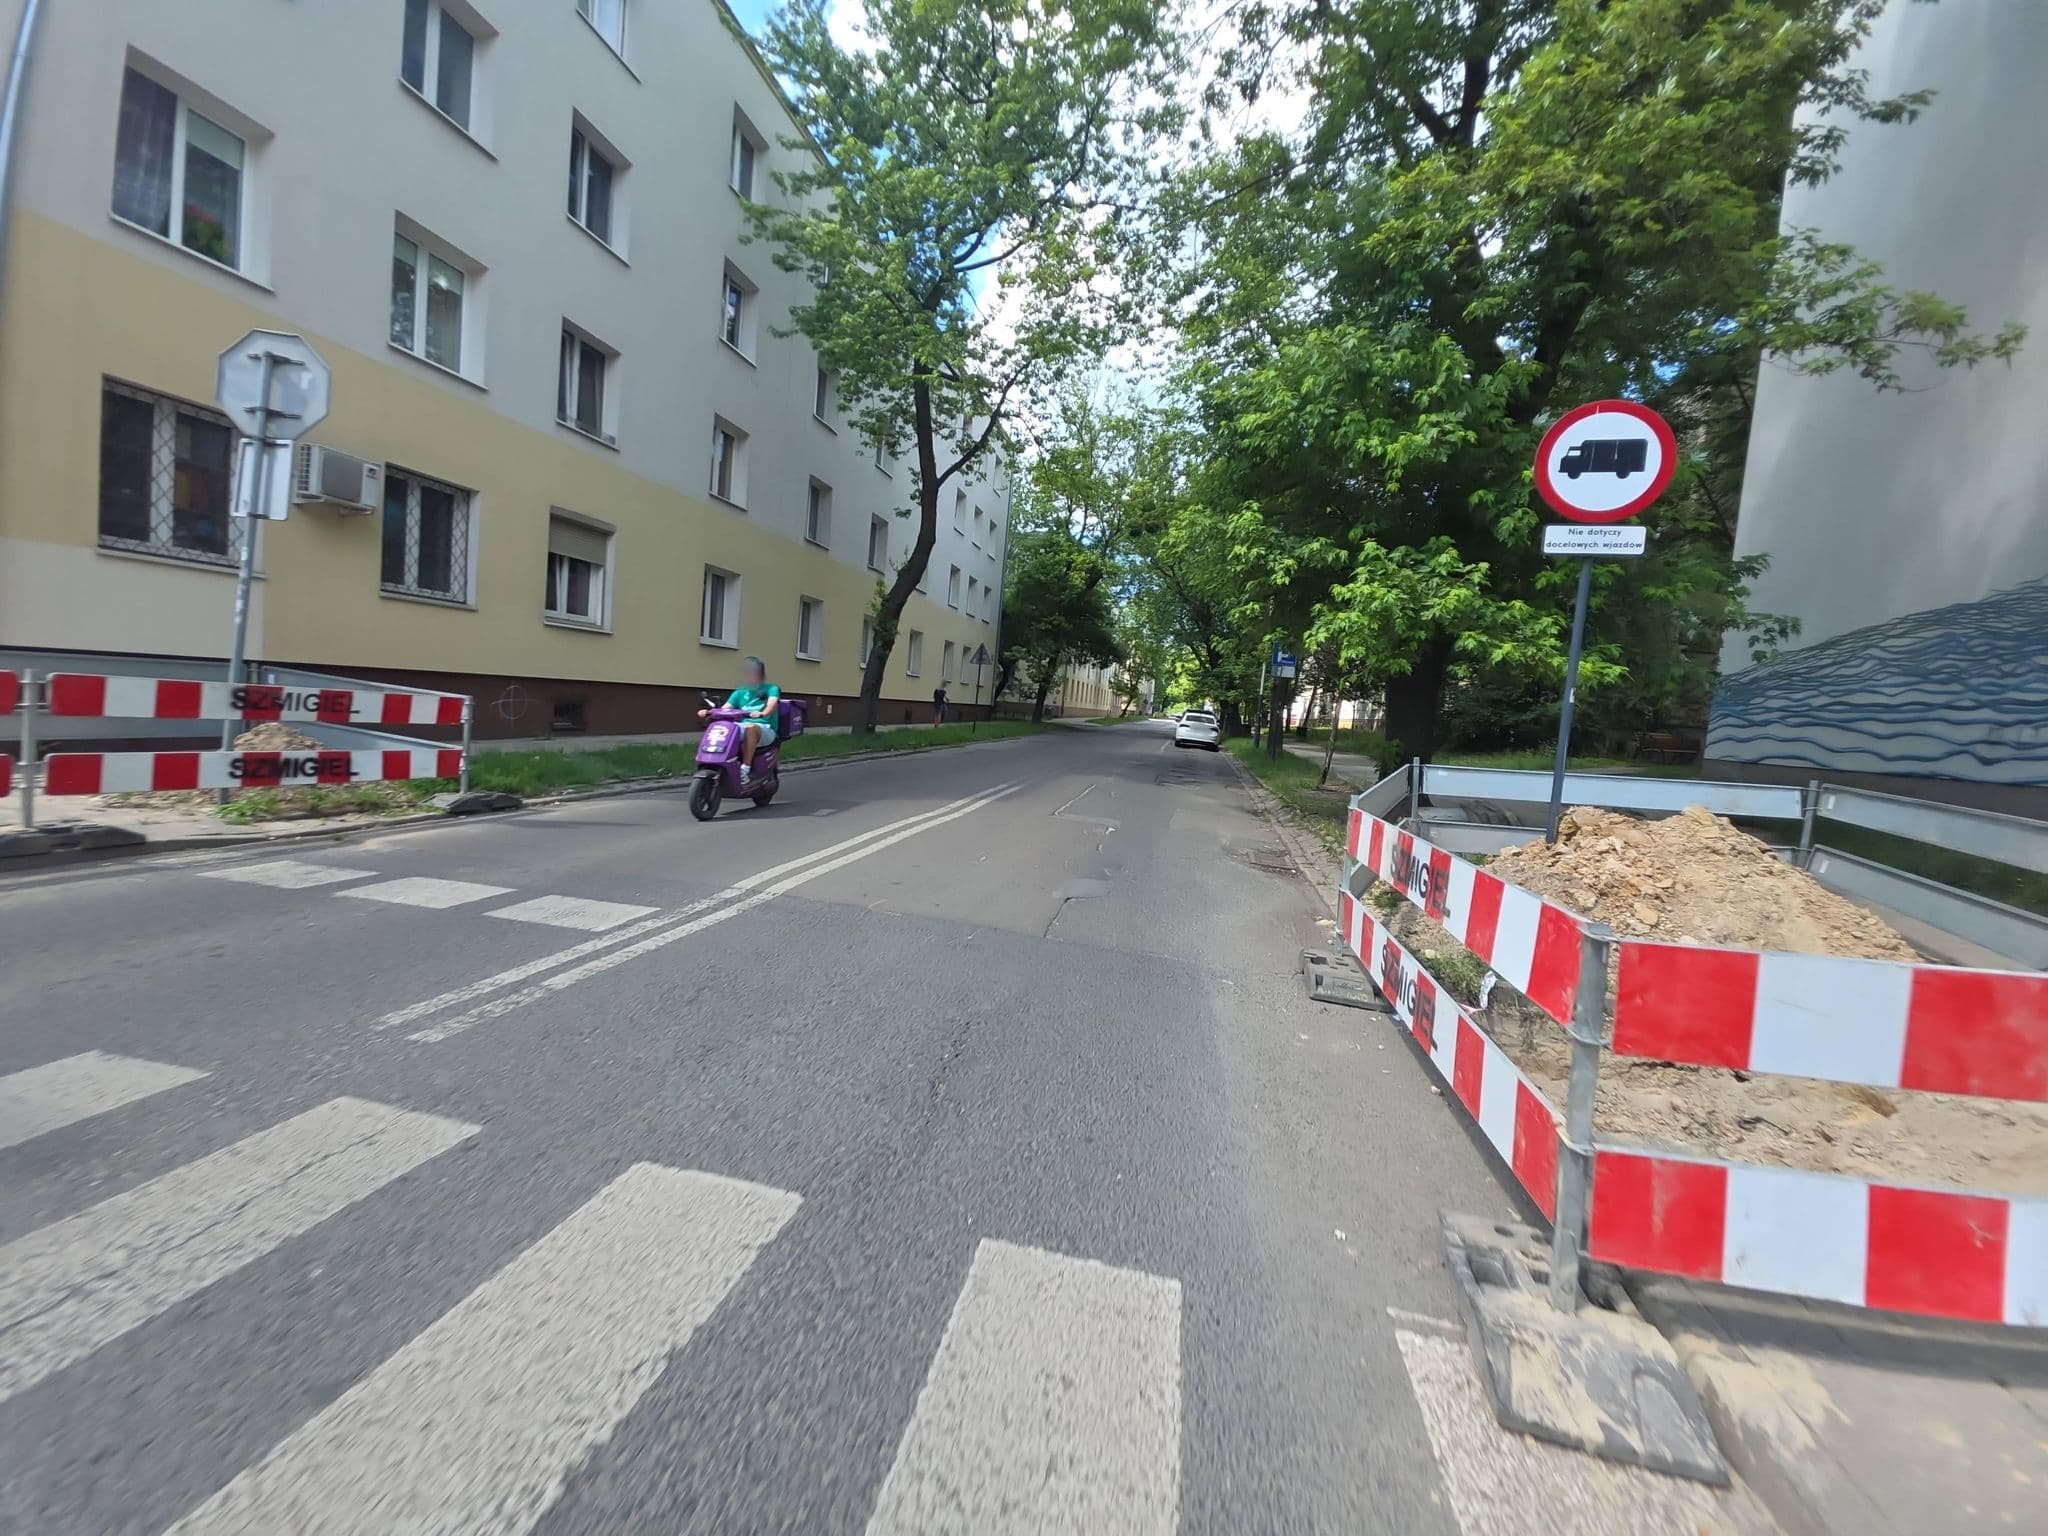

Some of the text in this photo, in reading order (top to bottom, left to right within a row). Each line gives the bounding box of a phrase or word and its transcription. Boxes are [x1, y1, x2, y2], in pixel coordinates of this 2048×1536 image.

[1545, 540, 1599, 550] docelowych
[1568, 527, 1621, 538] Nie dotyczy
[230, 686, 361, 714] SZMIGIEL
[228, 756, 360, 780] SZMIGIEL
[1390, 844, 1450, 918] SZMIGIEL
[1380, 944, 1438, 1052] SZMIGIEL
